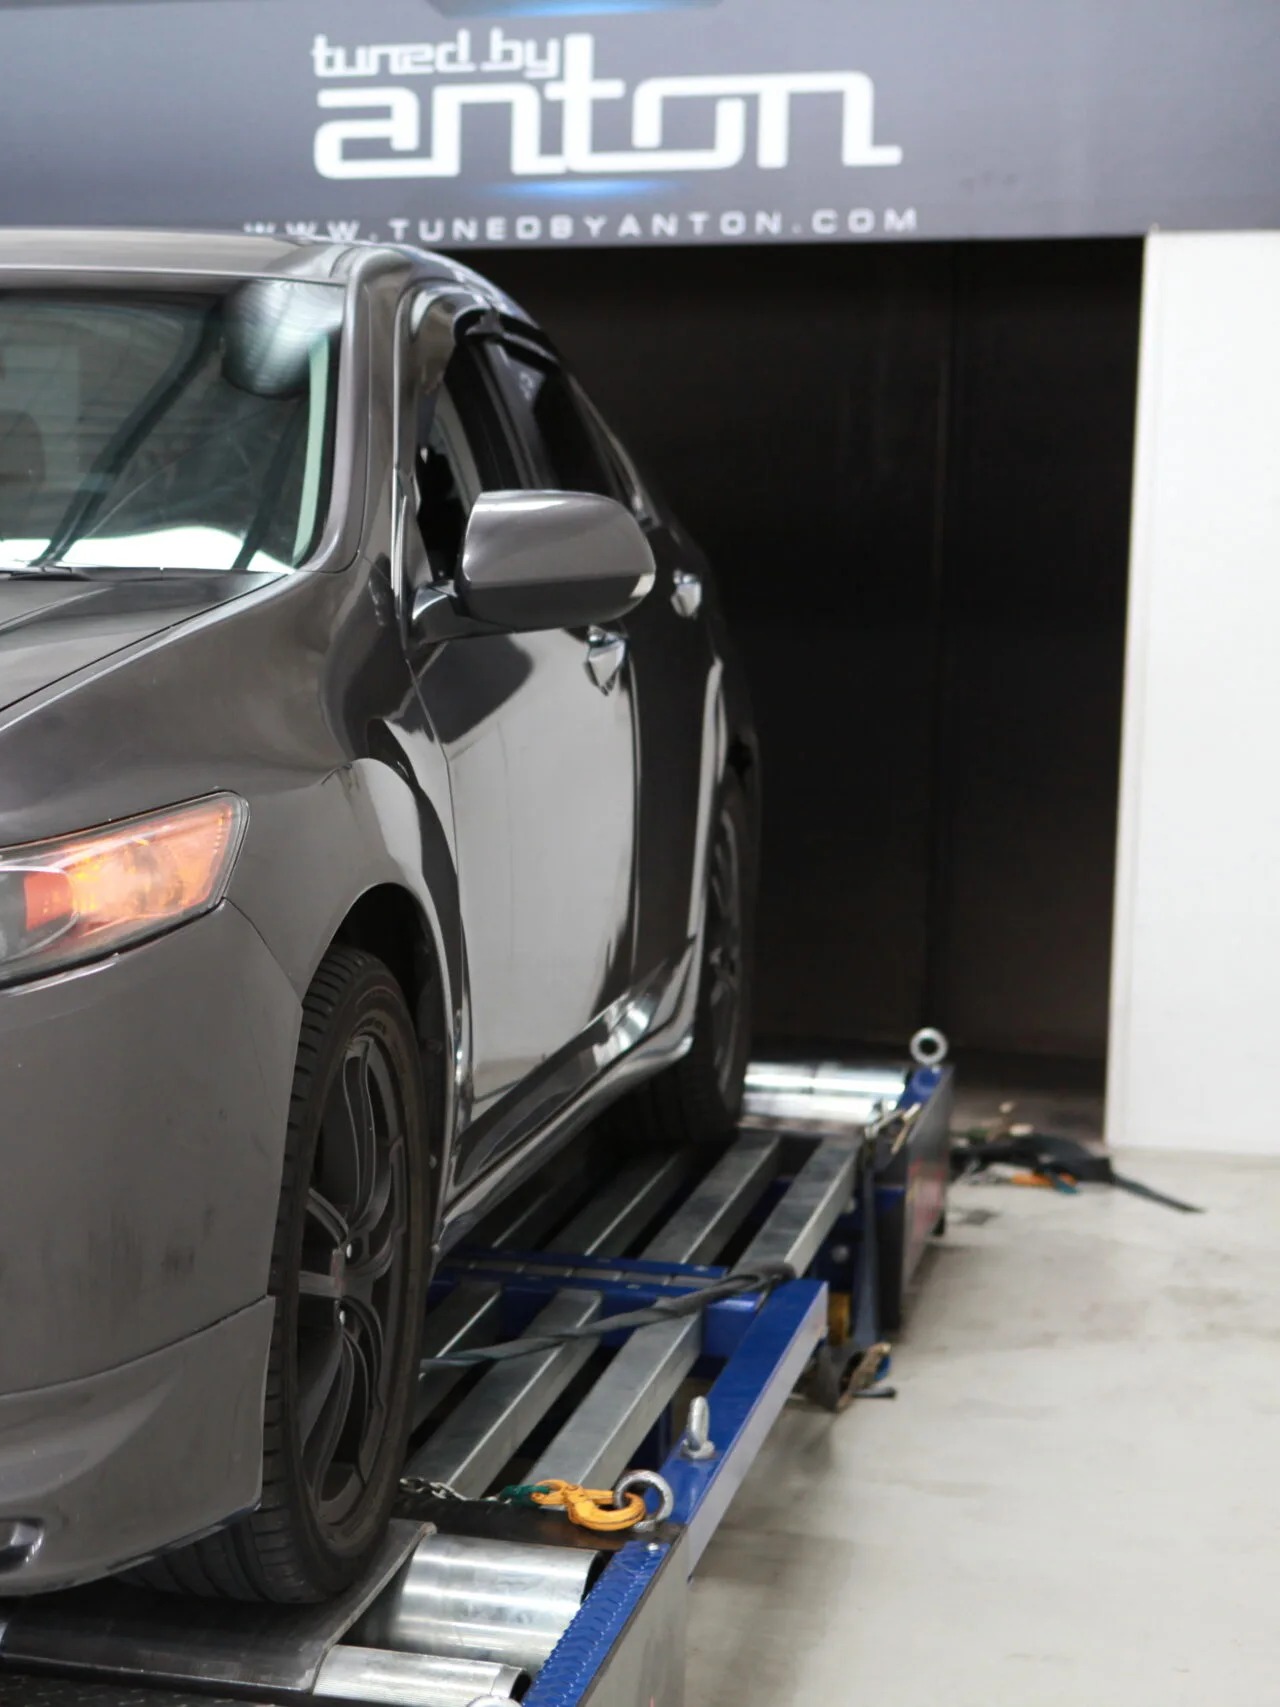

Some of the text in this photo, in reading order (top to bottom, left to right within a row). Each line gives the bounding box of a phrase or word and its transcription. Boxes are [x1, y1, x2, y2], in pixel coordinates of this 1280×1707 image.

[311, 27, 560, 79] tuned by
[314, 33, 903, 178] anton
